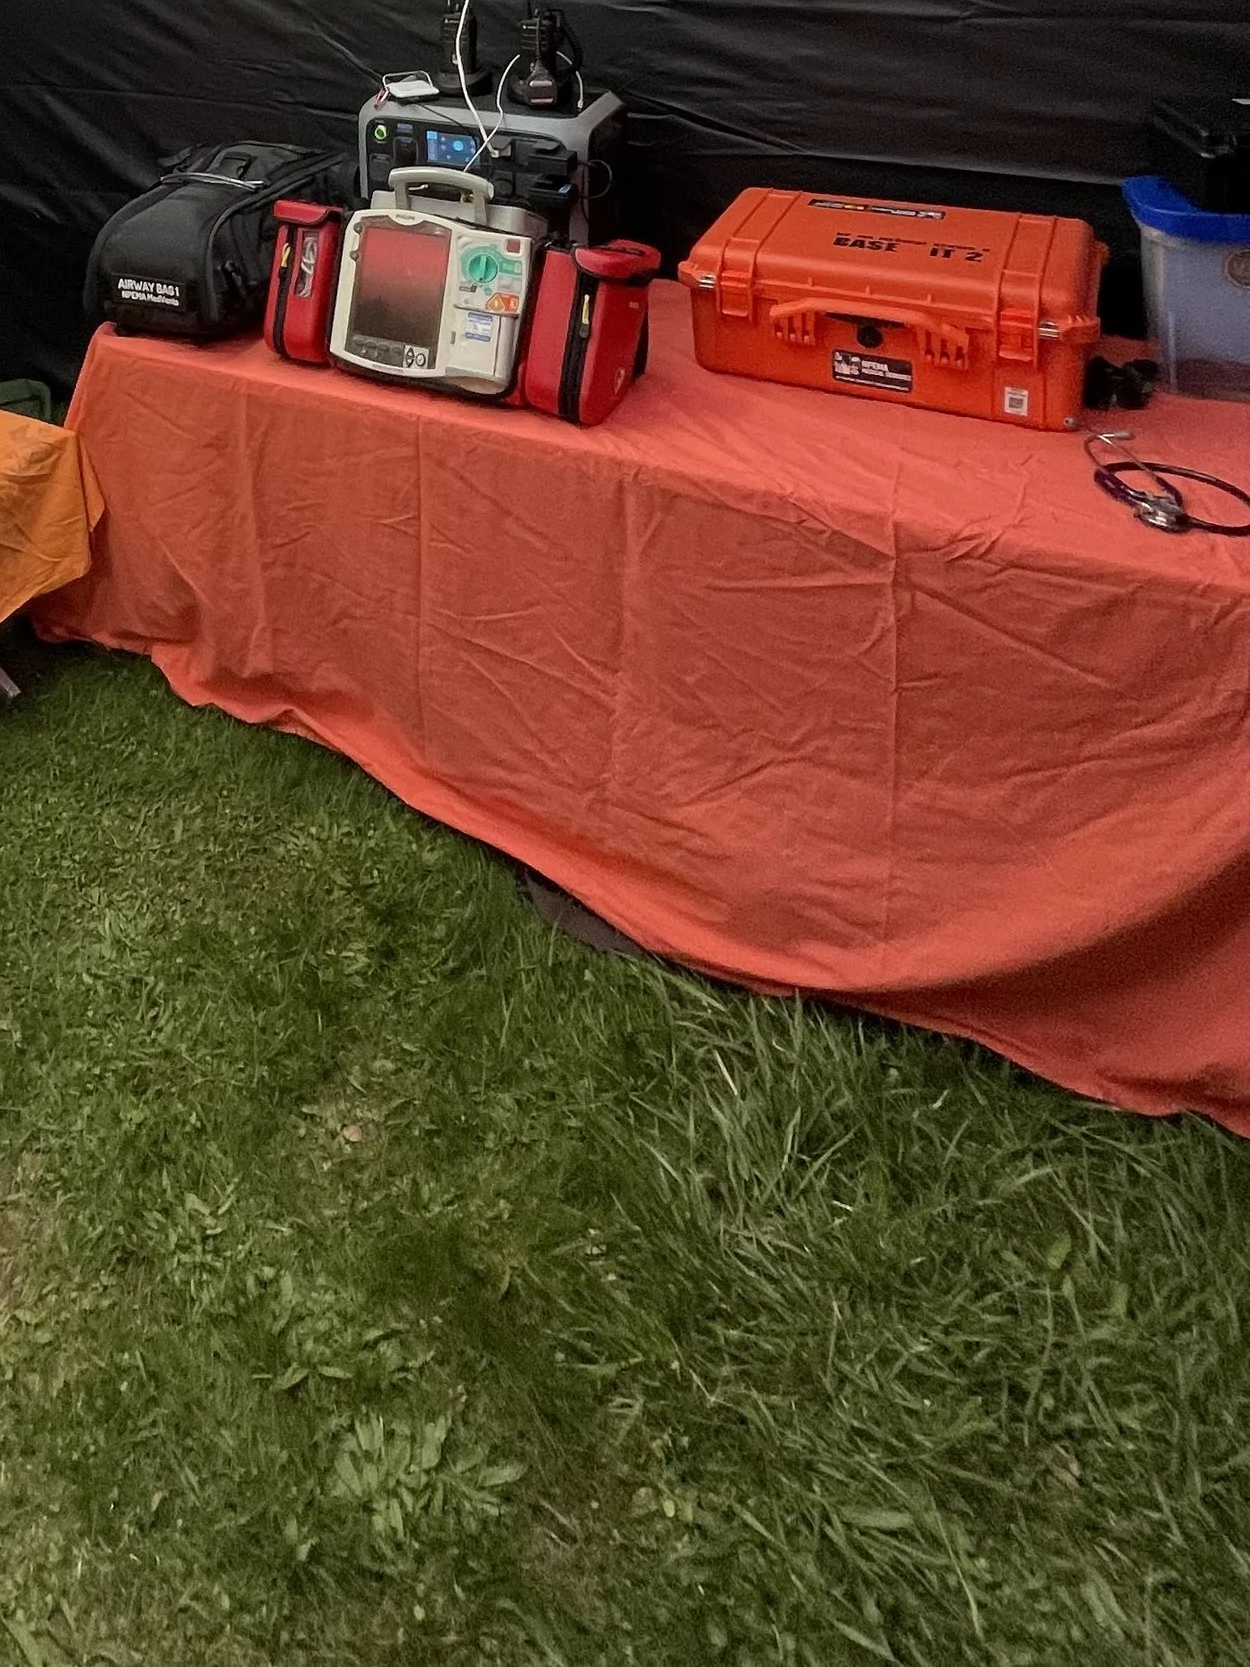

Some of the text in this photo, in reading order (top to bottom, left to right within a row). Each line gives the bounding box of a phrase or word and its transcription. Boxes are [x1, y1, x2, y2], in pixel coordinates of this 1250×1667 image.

[833, 237, 899, 253] BASE
[965, 251, 983, 263] 2
[118, 278, 180, 297] AIRWAY BAG 1
